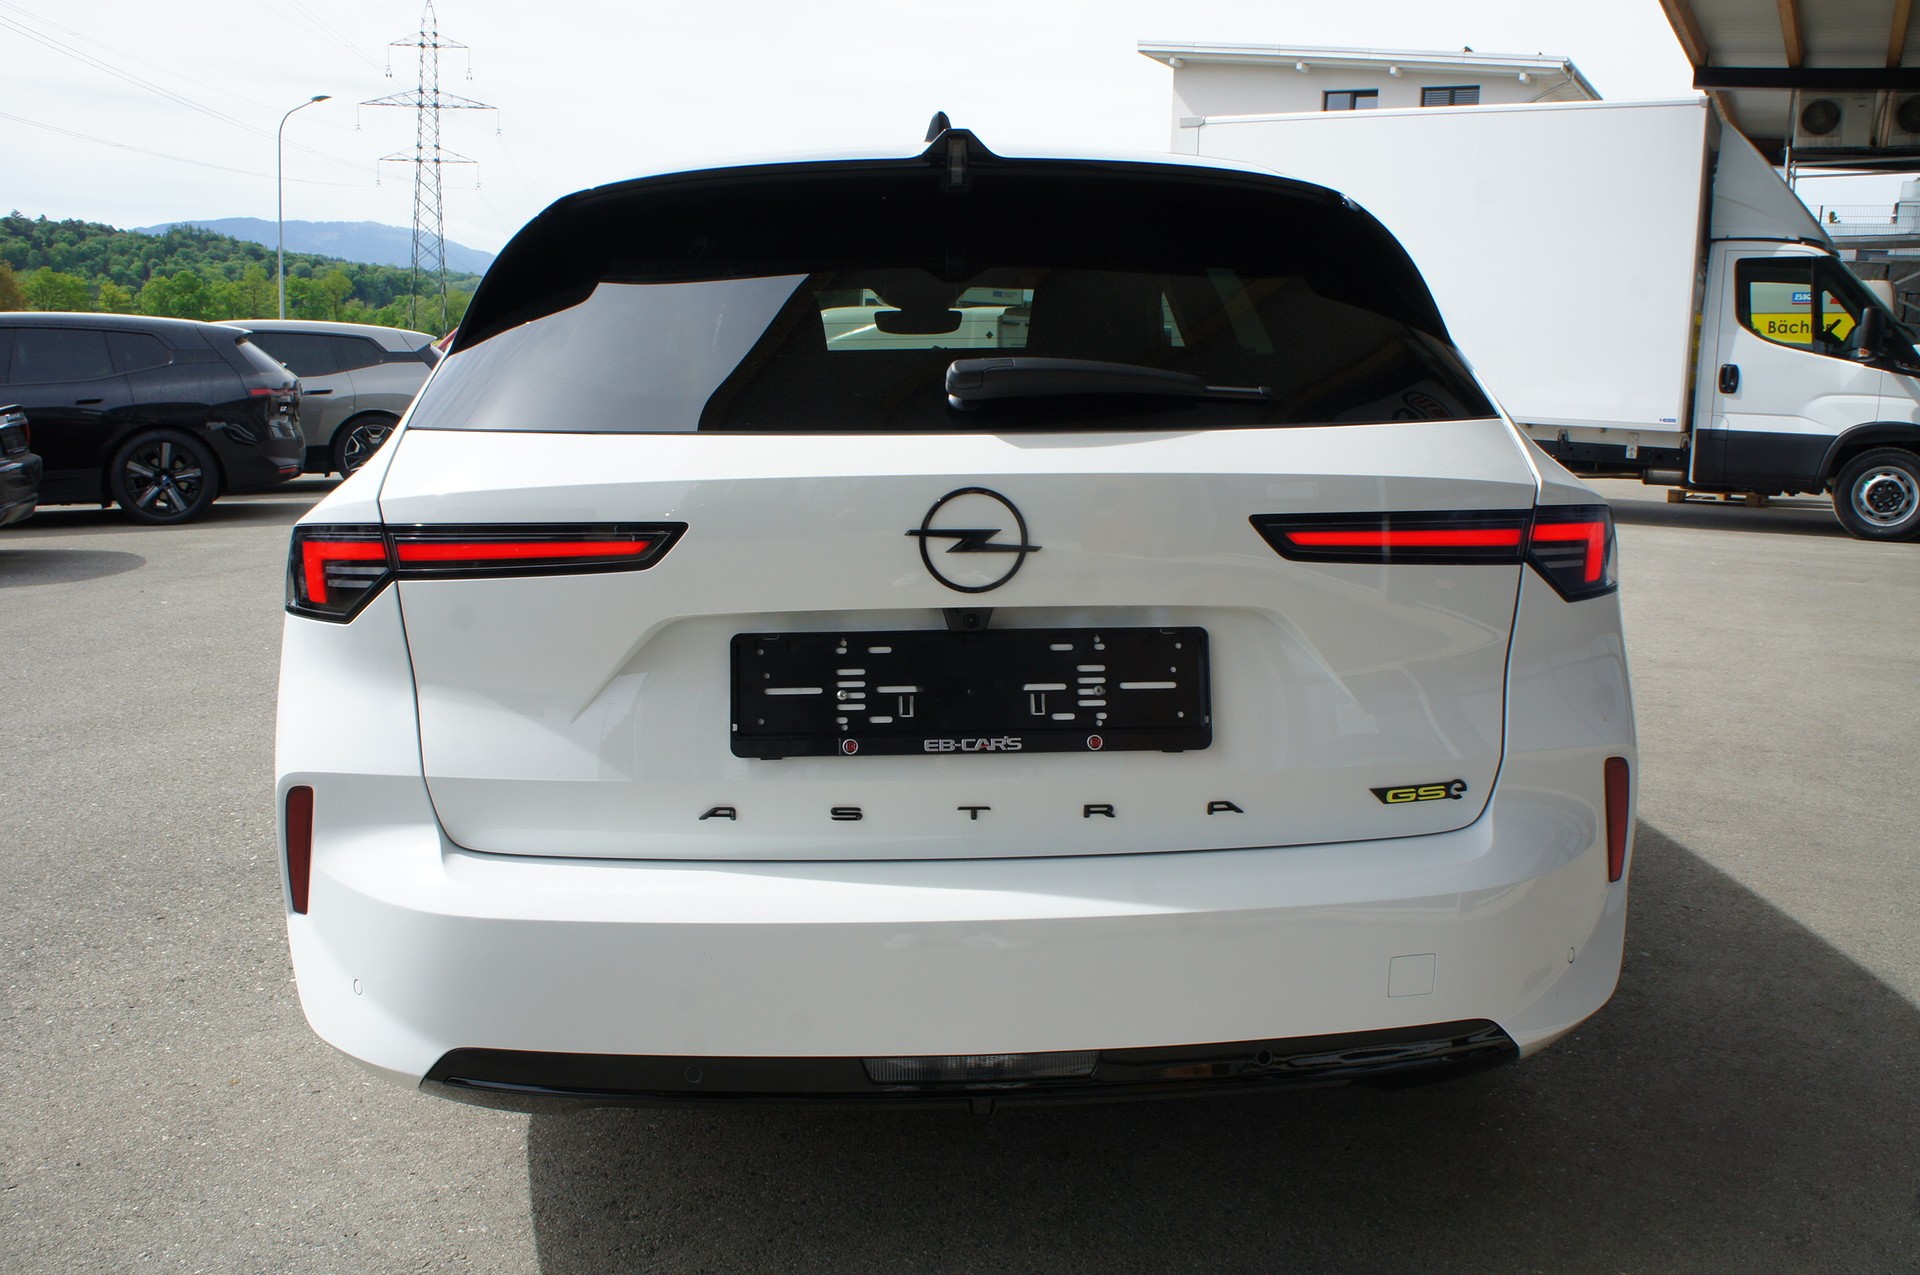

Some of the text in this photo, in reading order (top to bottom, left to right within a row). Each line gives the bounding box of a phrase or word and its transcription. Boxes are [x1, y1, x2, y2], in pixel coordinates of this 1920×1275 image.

[1768, 319, 1832, 335] Bächr
[1386, 779, 1467, 803] GSe
[699, 801, 1244, 820] ASTRA
